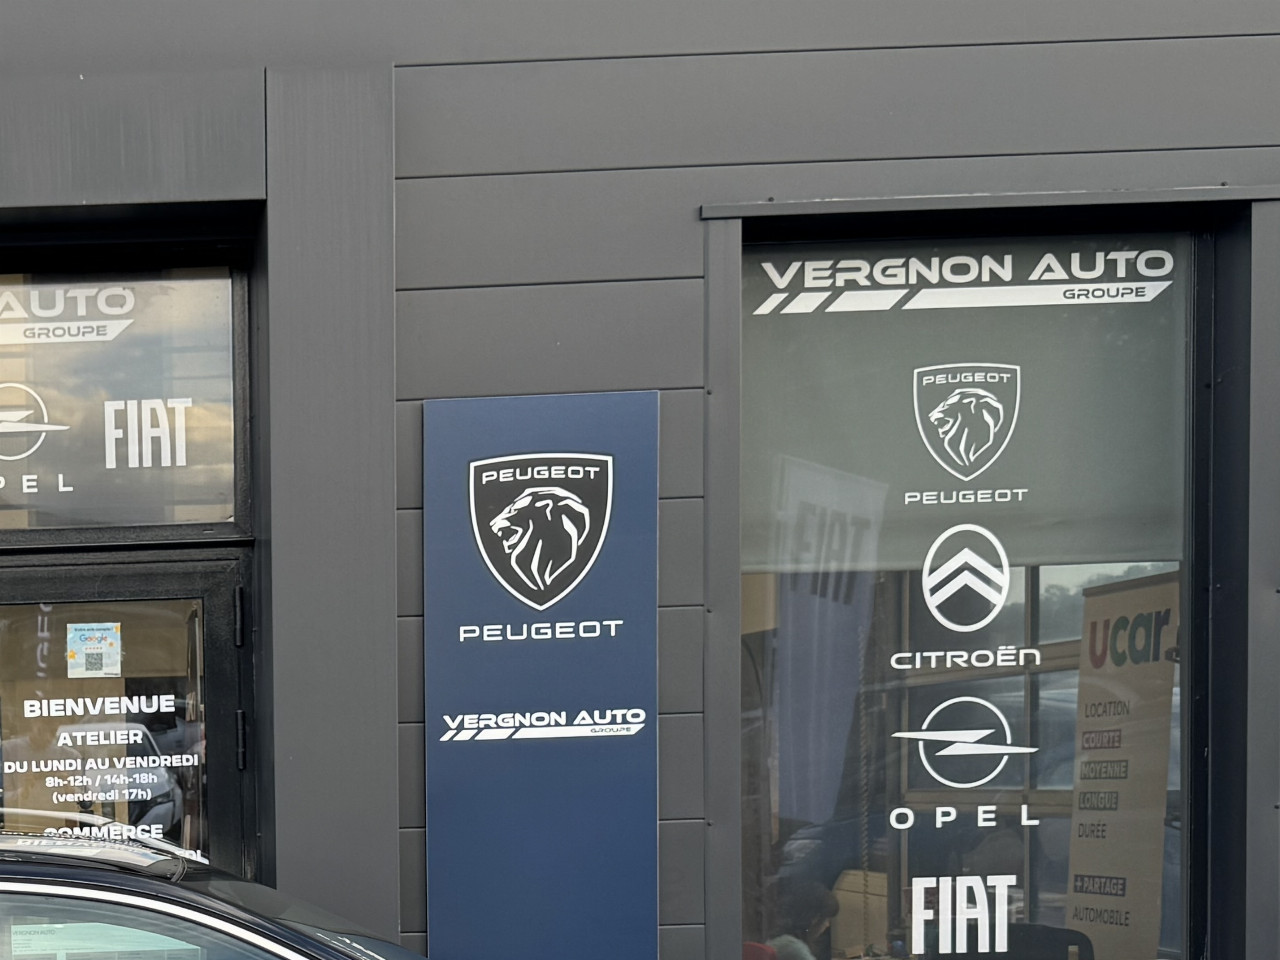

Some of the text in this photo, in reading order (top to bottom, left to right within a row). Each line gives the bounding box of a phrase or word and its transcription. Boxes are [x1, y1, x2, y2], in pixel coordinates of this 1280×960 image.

[761, 250, 1174, 289] VERGNON AUTO
[1062, 286, 1147, 300] GROUPE
[22, 323, 109, 340] GROUPE
[922, 372, 1012, 386] PEUGEOT
[104, 397, 193, 470] FIAT
[482, 466, 601, 484] PEUGEOT
[904, 488, 1030, 505] PEUGEOT
[79, 632, 108, 644] Google
[459, 620, 624, 642] PEUGEOT
[891, 646, 1041, 669] CITROËN
[23, 695, 176, 718] BIENVENUE
[1084, 700, 1131, 718] LOCATION
[443, 708, 646, 729] VERGNON AUTO
[57, 730, 143, 747] ATELIER
[1082, 731, 1121, 749] COURTE
[3, 754, 199, 773] DU LUNDI AU VENDREDI
[1080, 761, 1127, 779] MOYENNE
[45, 775, 92, 788] 8h-12h
[104, 773, 158, 785] 14h-18h
[52, 788, 153, 804] (vendredi 17h)
[1079, 792, 1118, 809] LONGUE
[889, 804, 1040, 830] OPEL
[43, 824, 164, 840] COMMERCE
[911, 874, 1017, 955] FIAT
[1072, 906, 1131, 926] AUTOMOBILE
